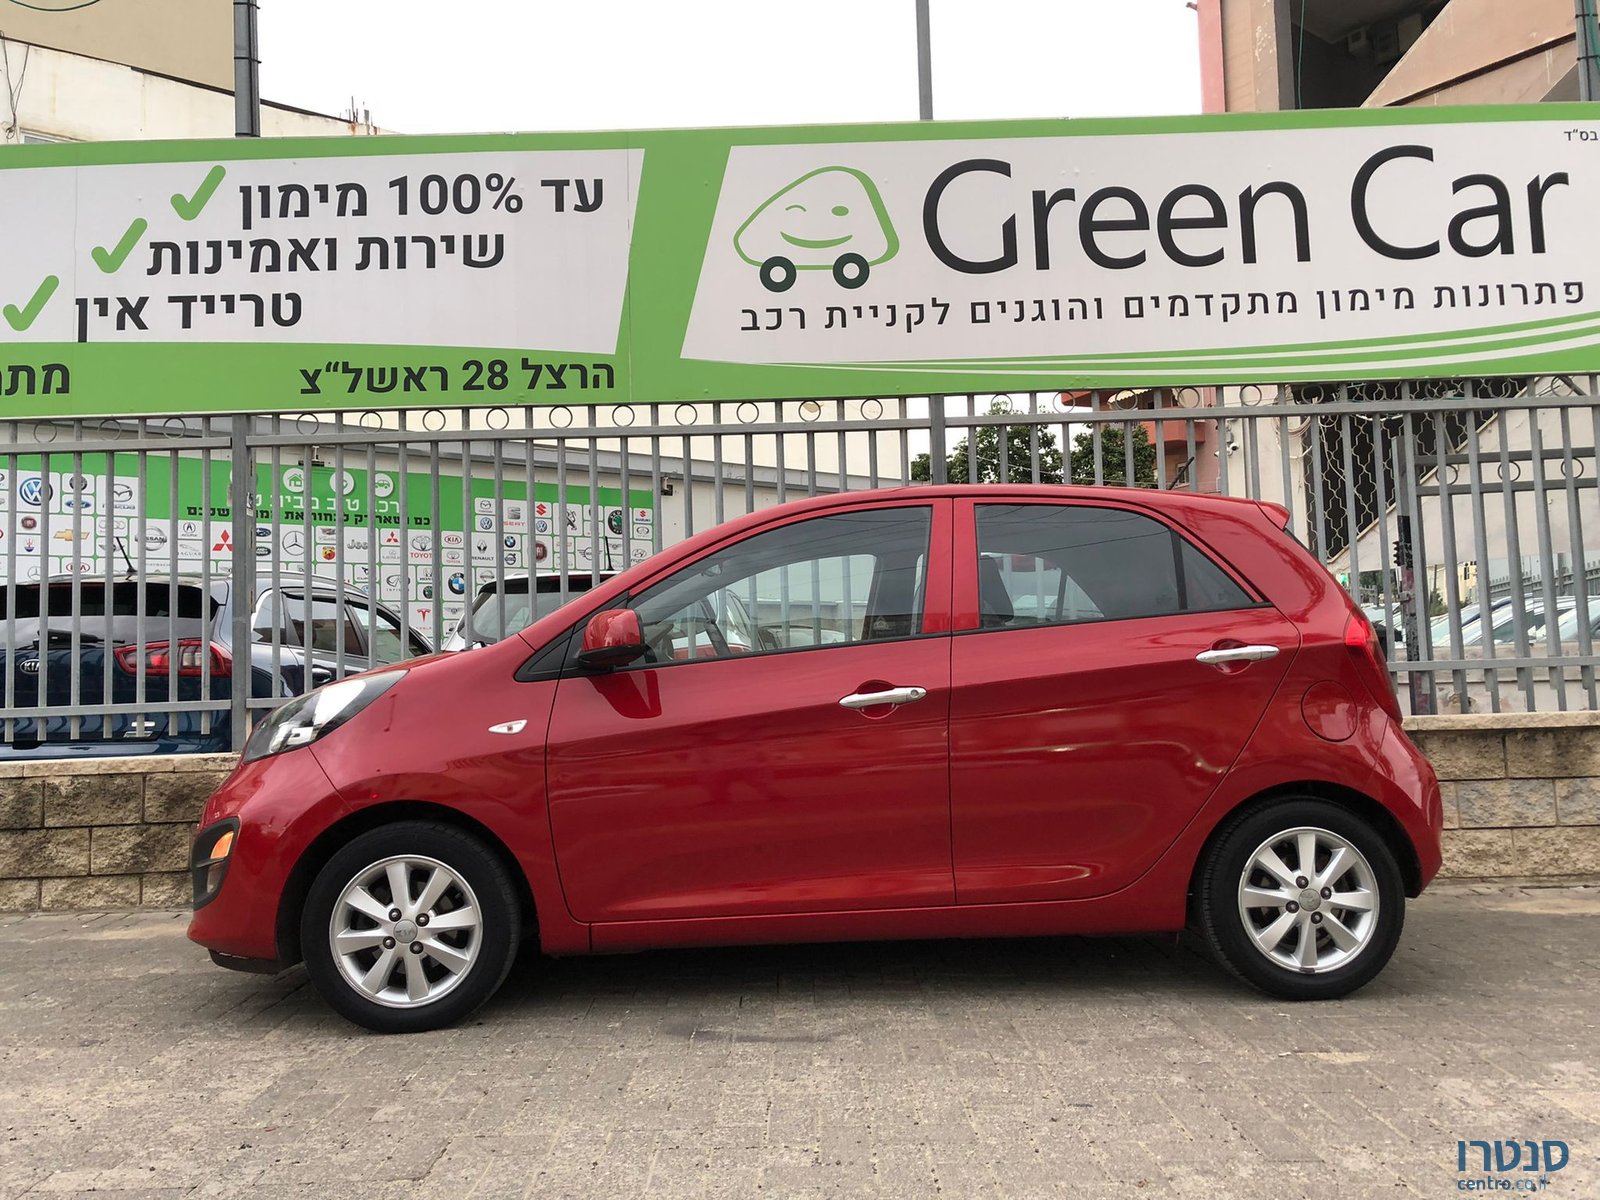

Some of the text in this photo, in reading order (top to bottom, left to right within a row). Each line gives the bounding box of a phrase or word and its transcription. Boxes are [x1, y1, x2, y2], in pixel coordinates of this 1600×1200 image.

[1563, 128, 1599, 142] בס"ד
[239, 173, 603, 230] עד 100% מימון
[922, 144, 1569, 275] Green Car
[146, 233, 504, 276] שירות ואמינות
[75, 292, 302, 344] טרייד אין
[740, 281, 1584, 334] פתרונות מימון מתקדמים והוגנים לקניית רכב
[0, 363, 70, 396] מת
[299, 357, 616, 395] הרצל 28 ראשל"צ
[327, 497, 360, 511] טב
[375, 500, 400, 513] רכ
[346, 539, 369, 550] Jee
